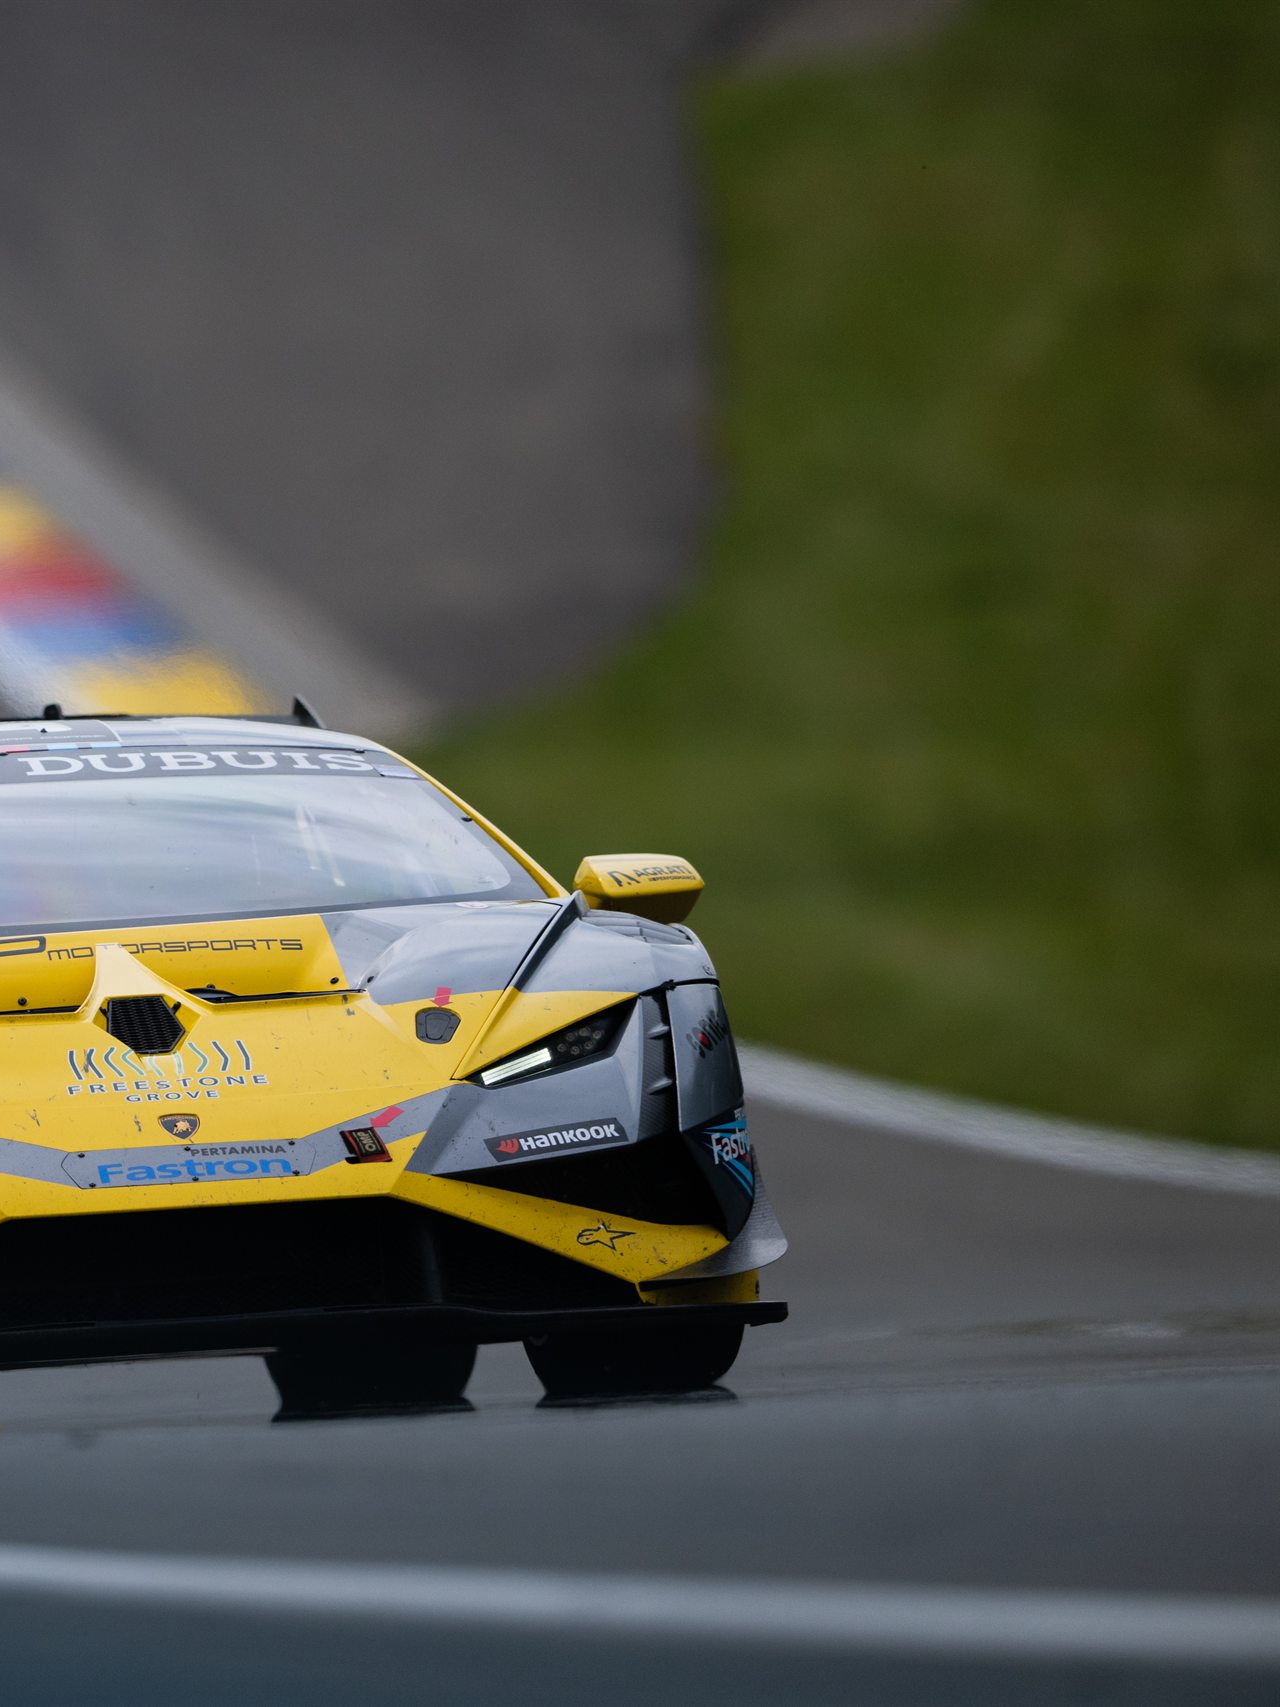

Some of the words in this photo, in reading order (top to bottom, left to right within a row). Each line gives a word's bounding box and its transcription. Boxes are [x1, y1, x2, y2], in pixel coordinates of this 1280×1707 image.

[17, 750, 375, 777] DUBUIS
[66, 1074, 270, 1096] FREESTONE
[125, 1089, 221, 1103] GROVE
[518, 1124, 620, 1151] HANKOOK
[190, 1145, 287, 1158] PERTAMINA
[97, 1158, 293, 1185] Fastron
